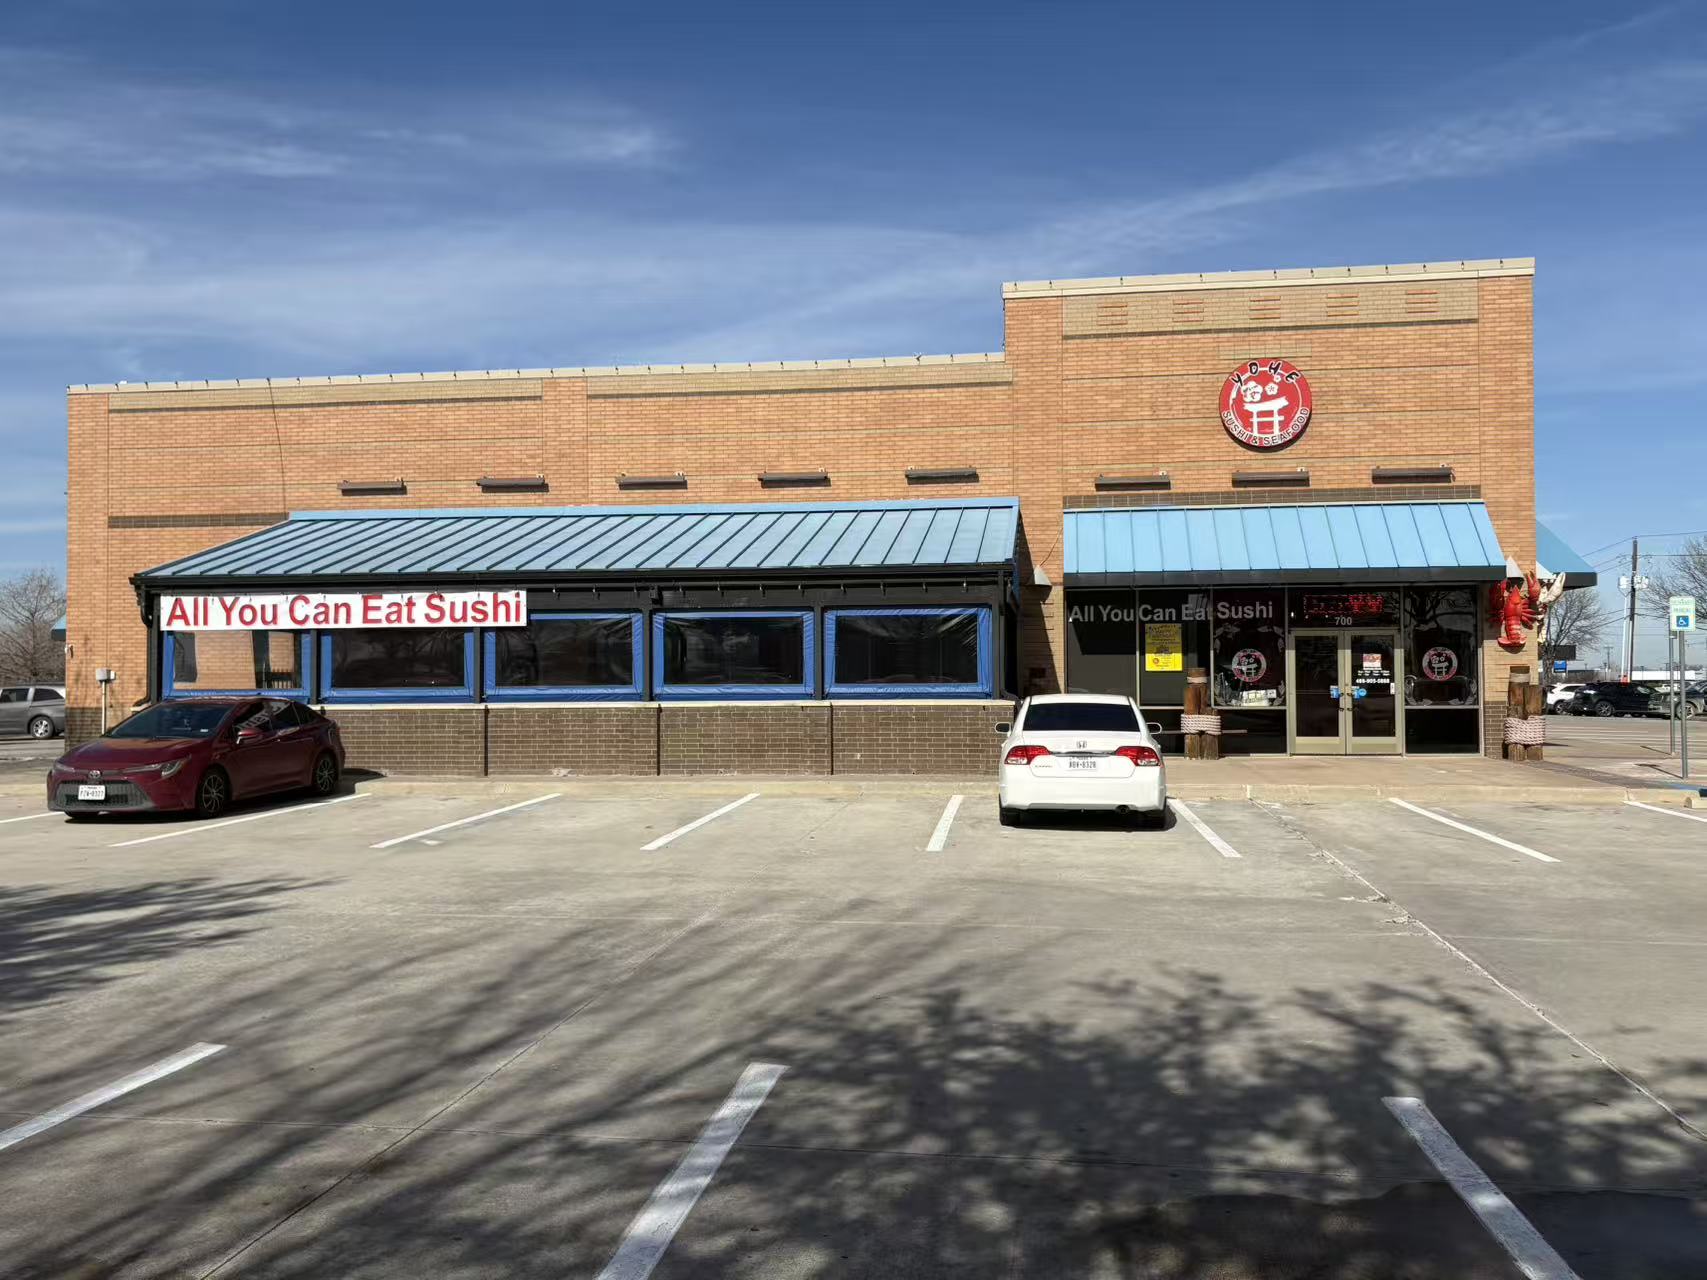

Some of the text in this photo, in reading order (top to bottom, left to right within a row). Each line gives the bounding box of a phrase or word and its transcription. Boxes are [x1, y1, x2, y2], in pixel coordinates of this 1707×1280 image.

[1230, 361, 1300, 387] YOHE
[1222, 407, 1309, 446] SUSHI & SEAFOOD
[166, 592, 522, 627] All You Can Eat Sushi
[1069, 602, 1273, 622] All You Can Eat Sushi
[1335, 617, 1352, 625] 700
